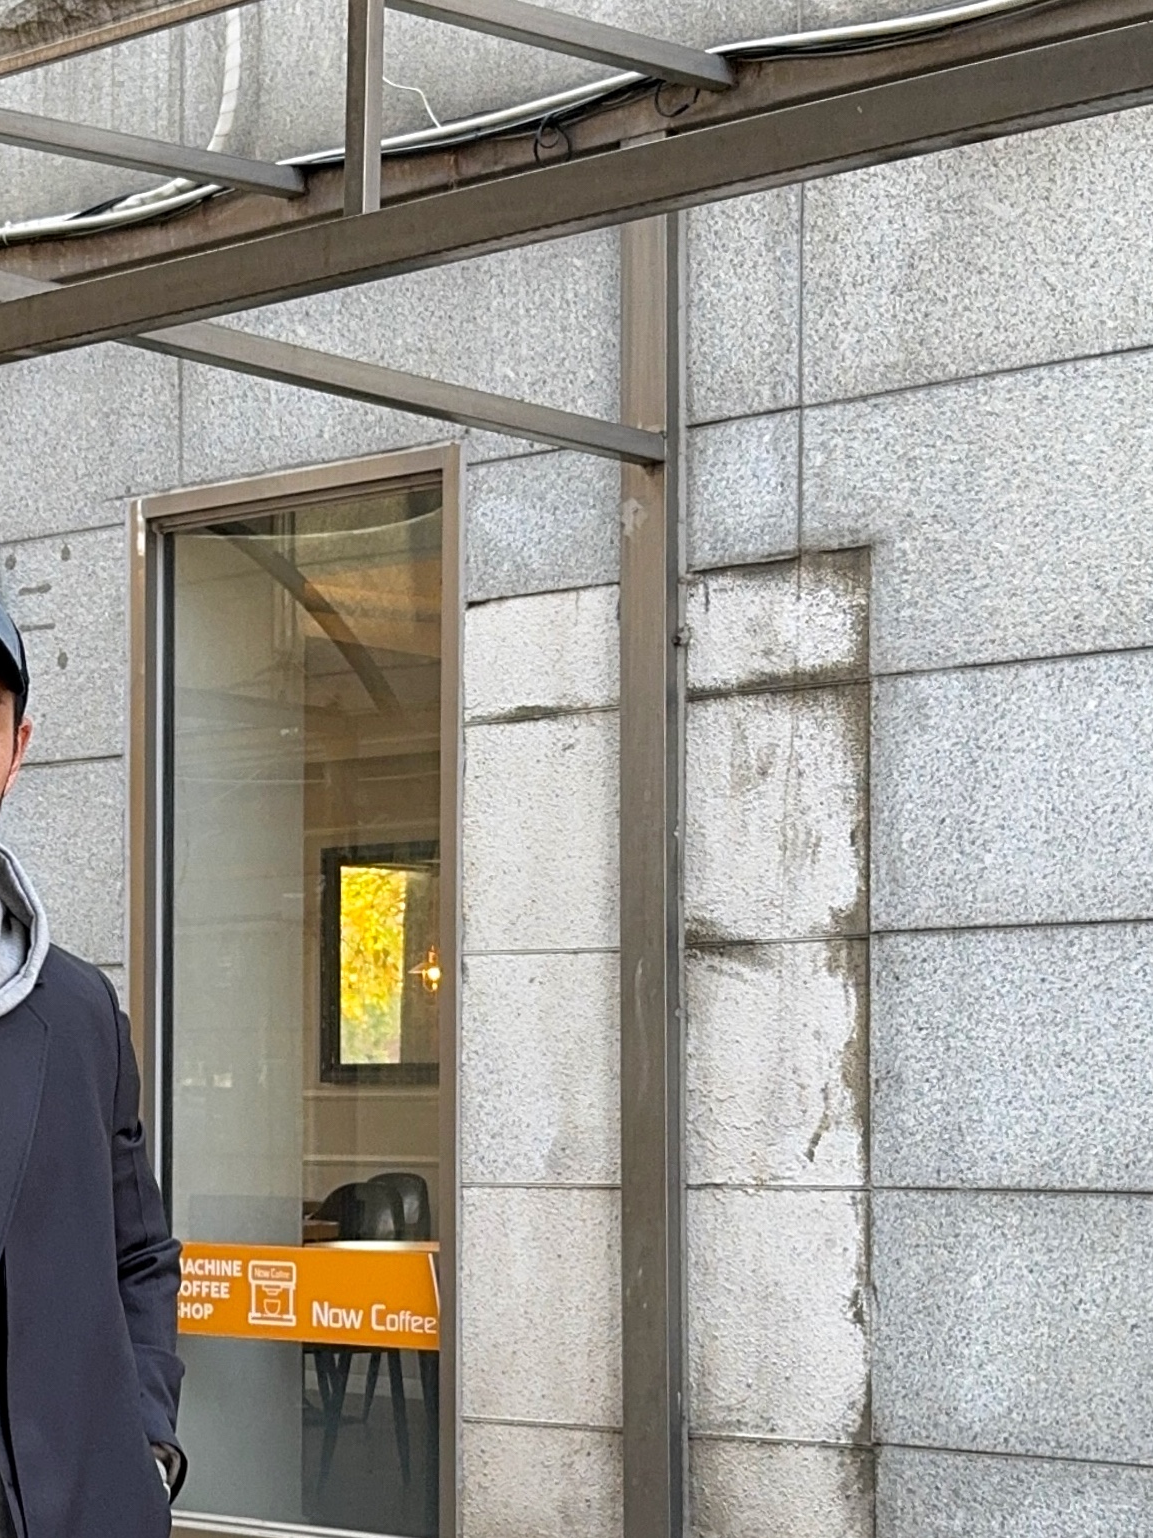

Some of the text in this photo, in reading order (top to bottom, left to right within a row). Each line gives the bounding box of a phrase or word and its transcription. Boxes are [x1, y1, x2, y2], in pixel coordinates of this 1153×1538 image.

[177, 1280, 230, 1299] OFFEE
[312, 1300, 437, 1334] Now Coffee
